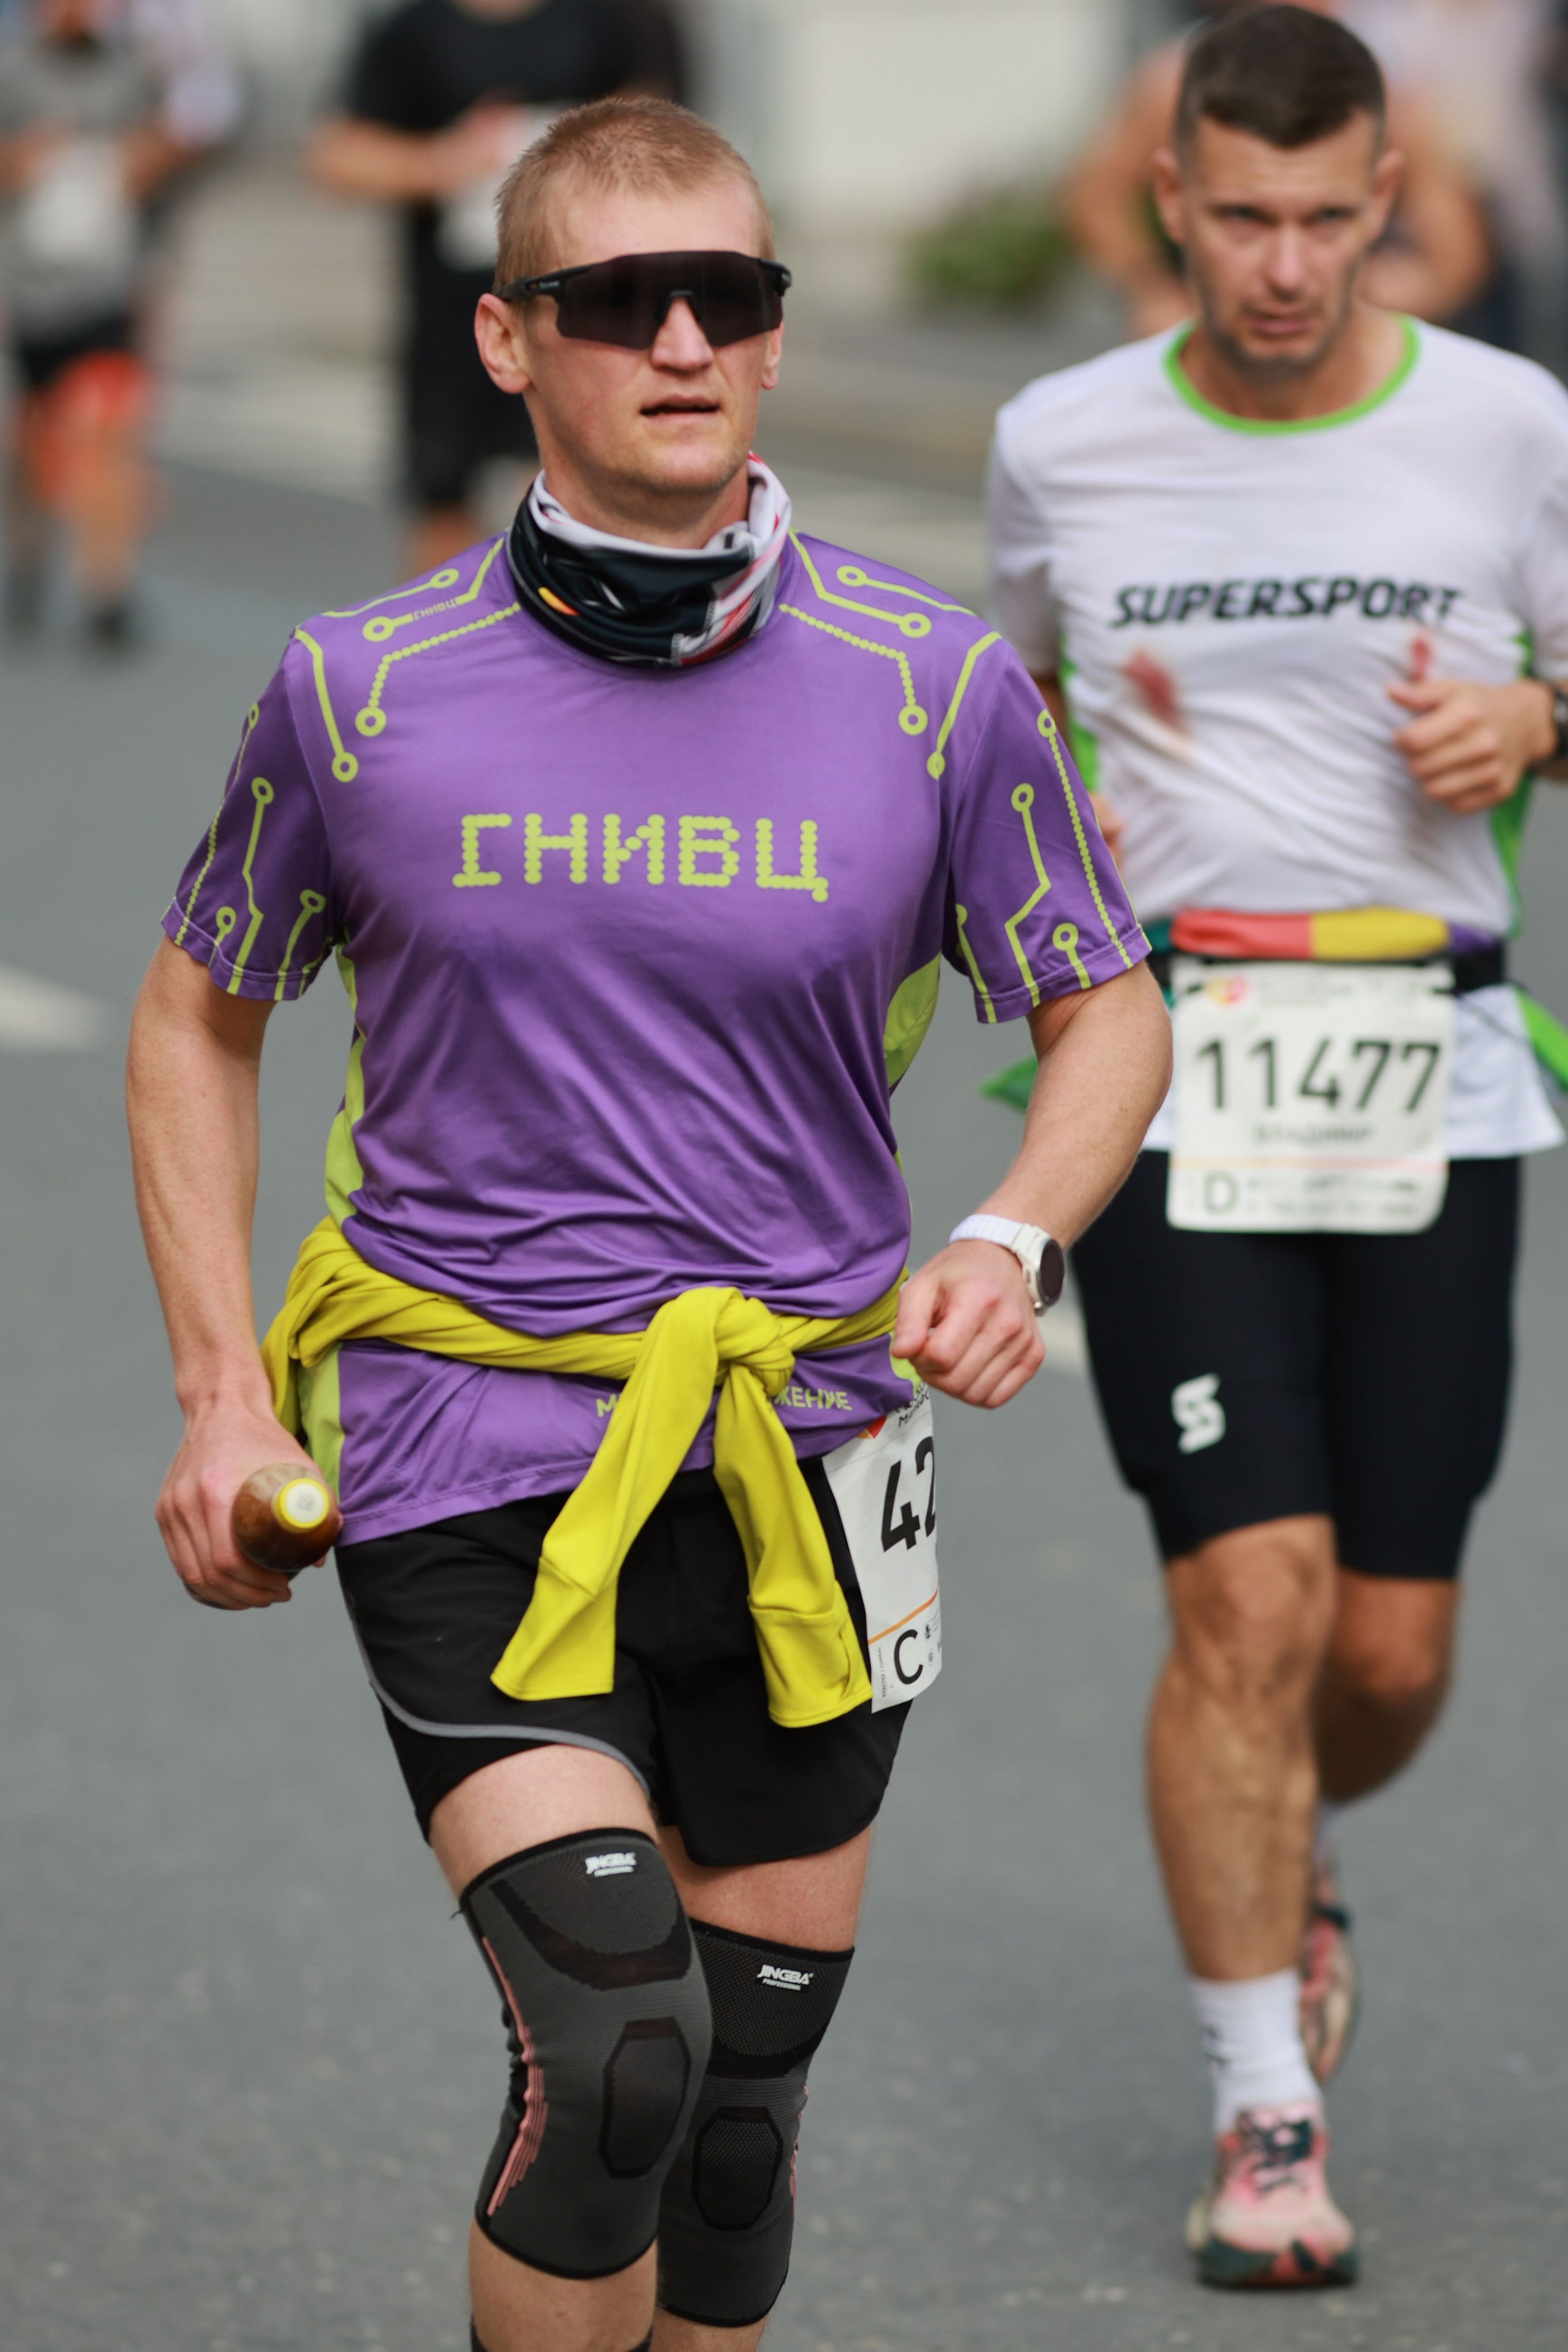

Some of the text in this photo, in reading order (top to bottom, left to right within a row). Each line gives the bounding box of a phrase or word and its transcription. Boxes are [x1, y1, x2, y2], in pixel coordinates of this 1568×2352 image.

[1109, 575, 1463, 628] SUPERSPORT
[452, 813, 828, 903] ГНИВЦ
[1196, 1035, 1441, 1114] 11477
[1203, 1172, 1237, 1215] D
[756, 1964, 810, 1985] JINGBA
